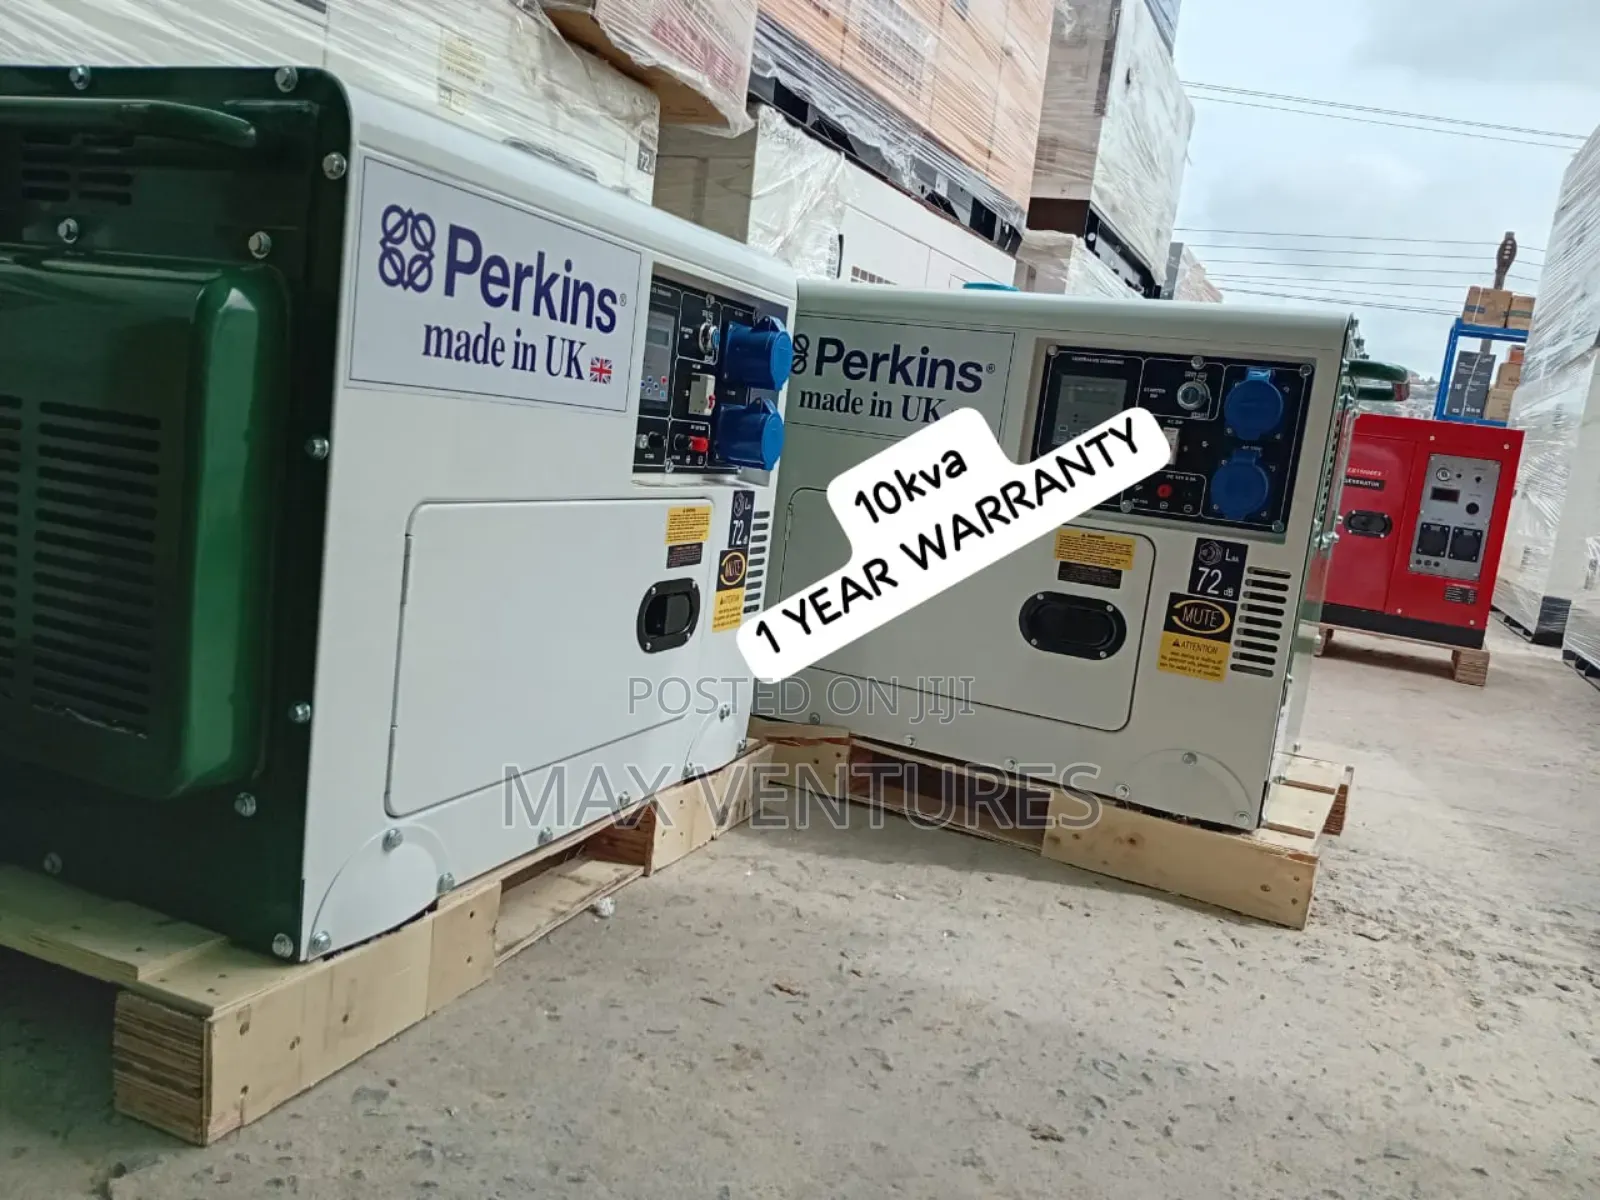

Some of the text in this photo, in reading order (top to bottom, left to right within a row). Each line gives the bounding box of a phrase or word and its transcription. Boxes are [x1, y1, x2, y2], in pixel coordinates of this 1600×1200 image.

[443, 223, 617, 334] Perkins
[422, 321, 586, 380] made in UK
[814, 336, 983, 393] Perkins
[798, 388, 947, 423] made in UK
[731, 519, 744, 546] 72
[1196, 567, 1222, 595] 72
[1182, 605, 1220, 628] MUTE
[1181, 641, 1219, 655] ATTENTION
